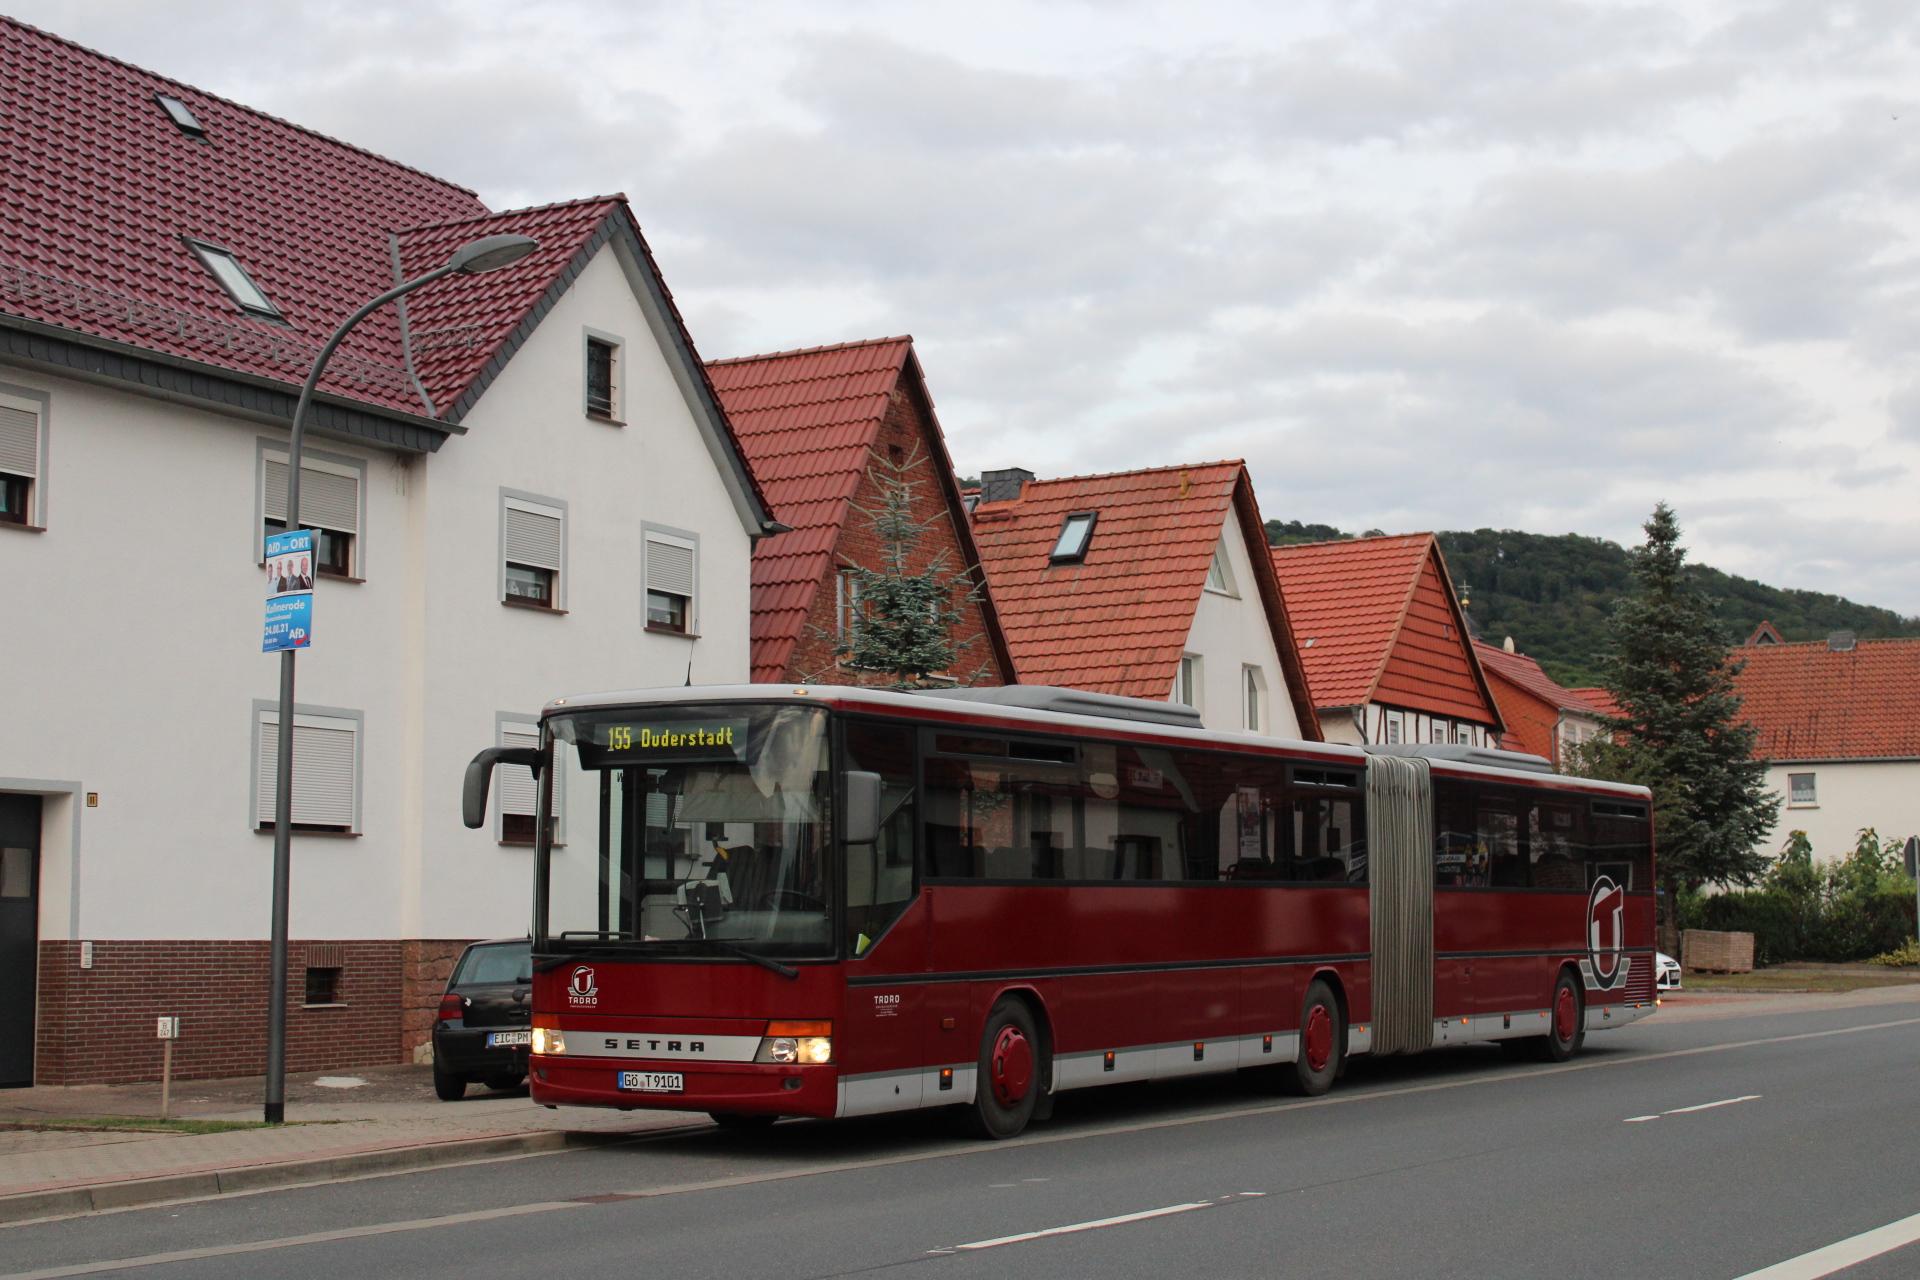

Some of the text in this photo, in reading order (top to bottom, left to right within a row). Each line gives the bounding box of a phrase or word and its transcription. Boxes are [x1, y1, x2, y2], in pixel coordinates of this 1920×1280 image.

[267, 542, 280, 554] AfD
[290, 537, 309, 549] ORT
[289, 628, 305, 639] AfD
[607, 727, 733, 751] 155 Duderstadt
[494, 1032, 529, 1043] EIC PM
[604, 1038, 705, 1052] SETRA
[624, 1074, 638, 1087] GÖ
[653, 1075, 681, 1089] 9101
